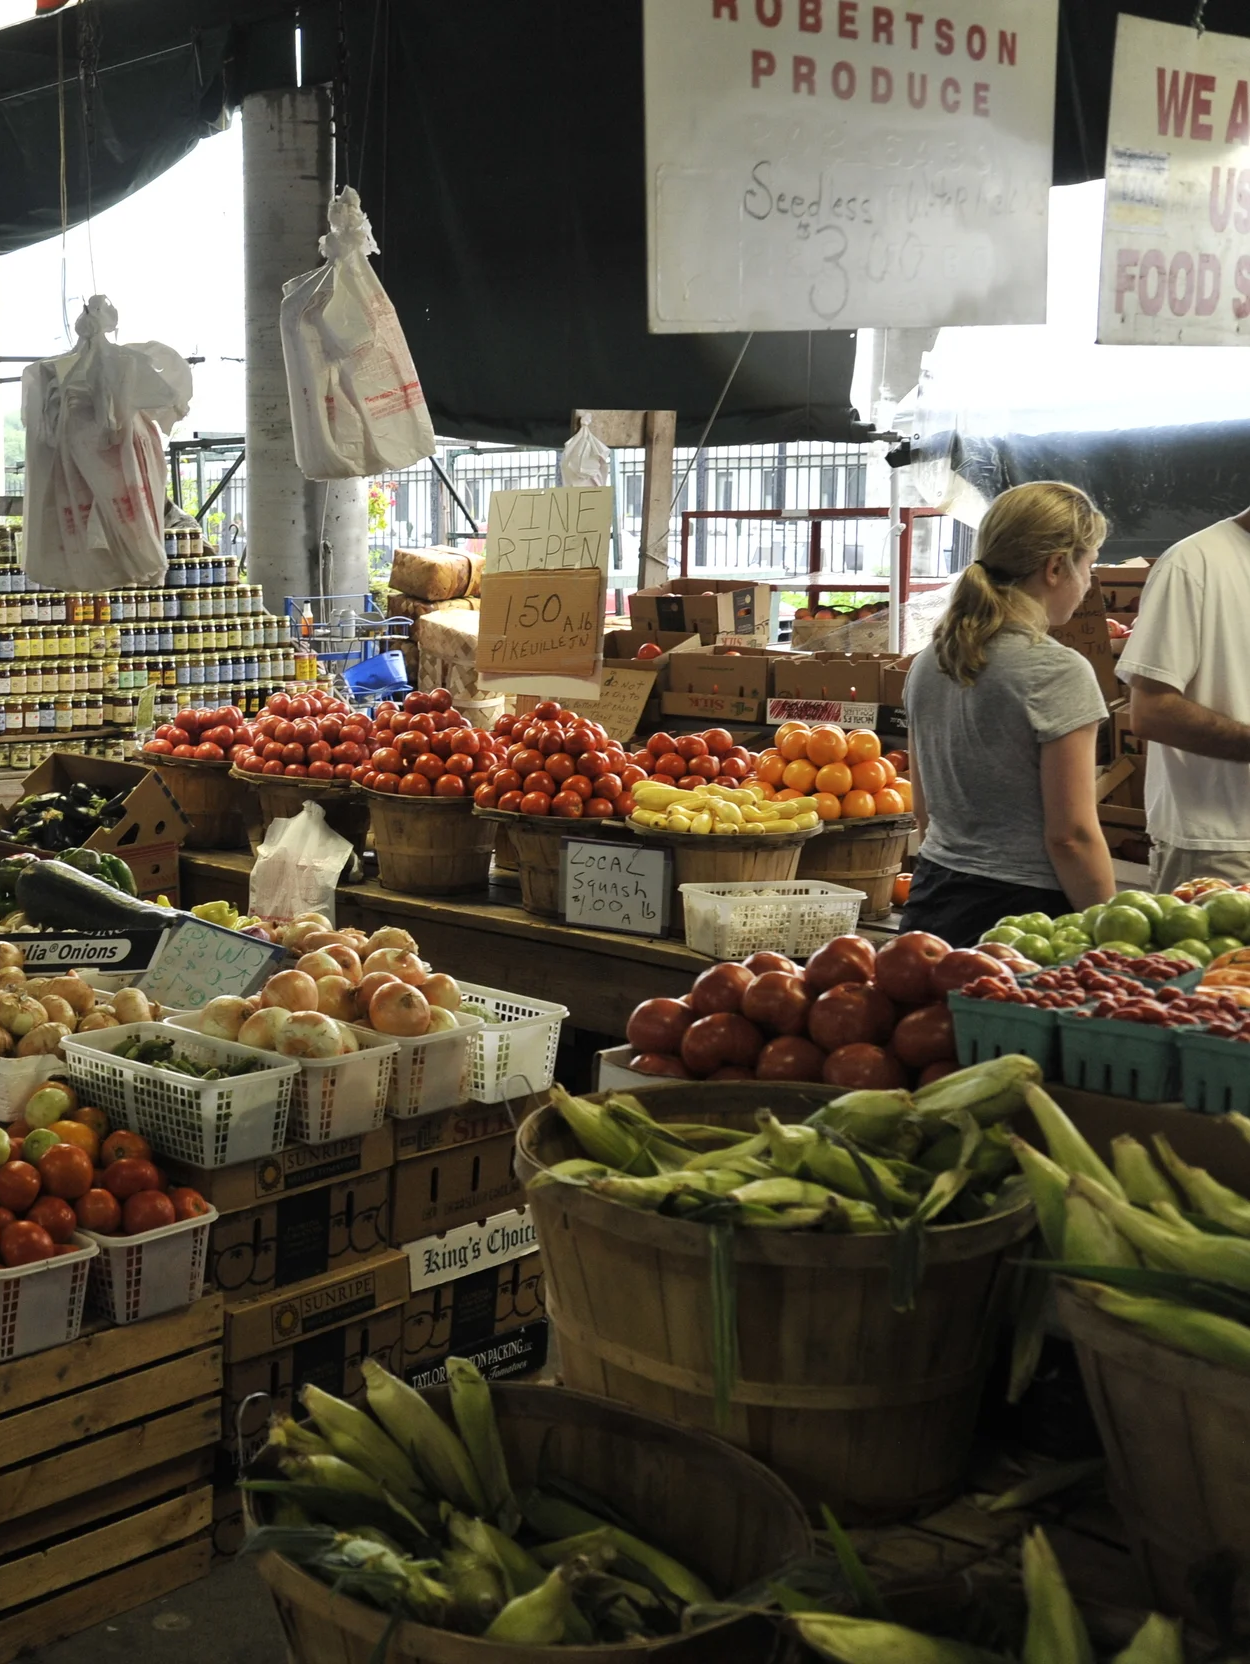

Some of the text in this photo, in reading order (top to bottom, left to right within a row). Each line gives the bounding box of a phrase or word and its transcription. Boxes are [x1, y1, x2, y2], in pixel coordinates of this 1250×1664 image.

[712, 0, 1017, 66] ROBERTSON
[751, 49, 990, 118] PRODUCE
[1156, 66, 1217, 142] WE
[743, 159, 875, 224] Seedless
[1114, 247, 1222, 317] FOOD
[495, 490, 603, 534] VINE
[688, 697, 725, 711] SILK
[570, 846, 646, 877] LOCAL
[621, 913, 632, 926] A
[58, 943, 119, 960] Onions
[286, 1138, 359, 1170] SUNRIPE
[422, 1236, 482, 1276] King's
[303, 1278, 373, 1314] SUNRIPE
[411, 1365, 447, 1391] TAYLOR
